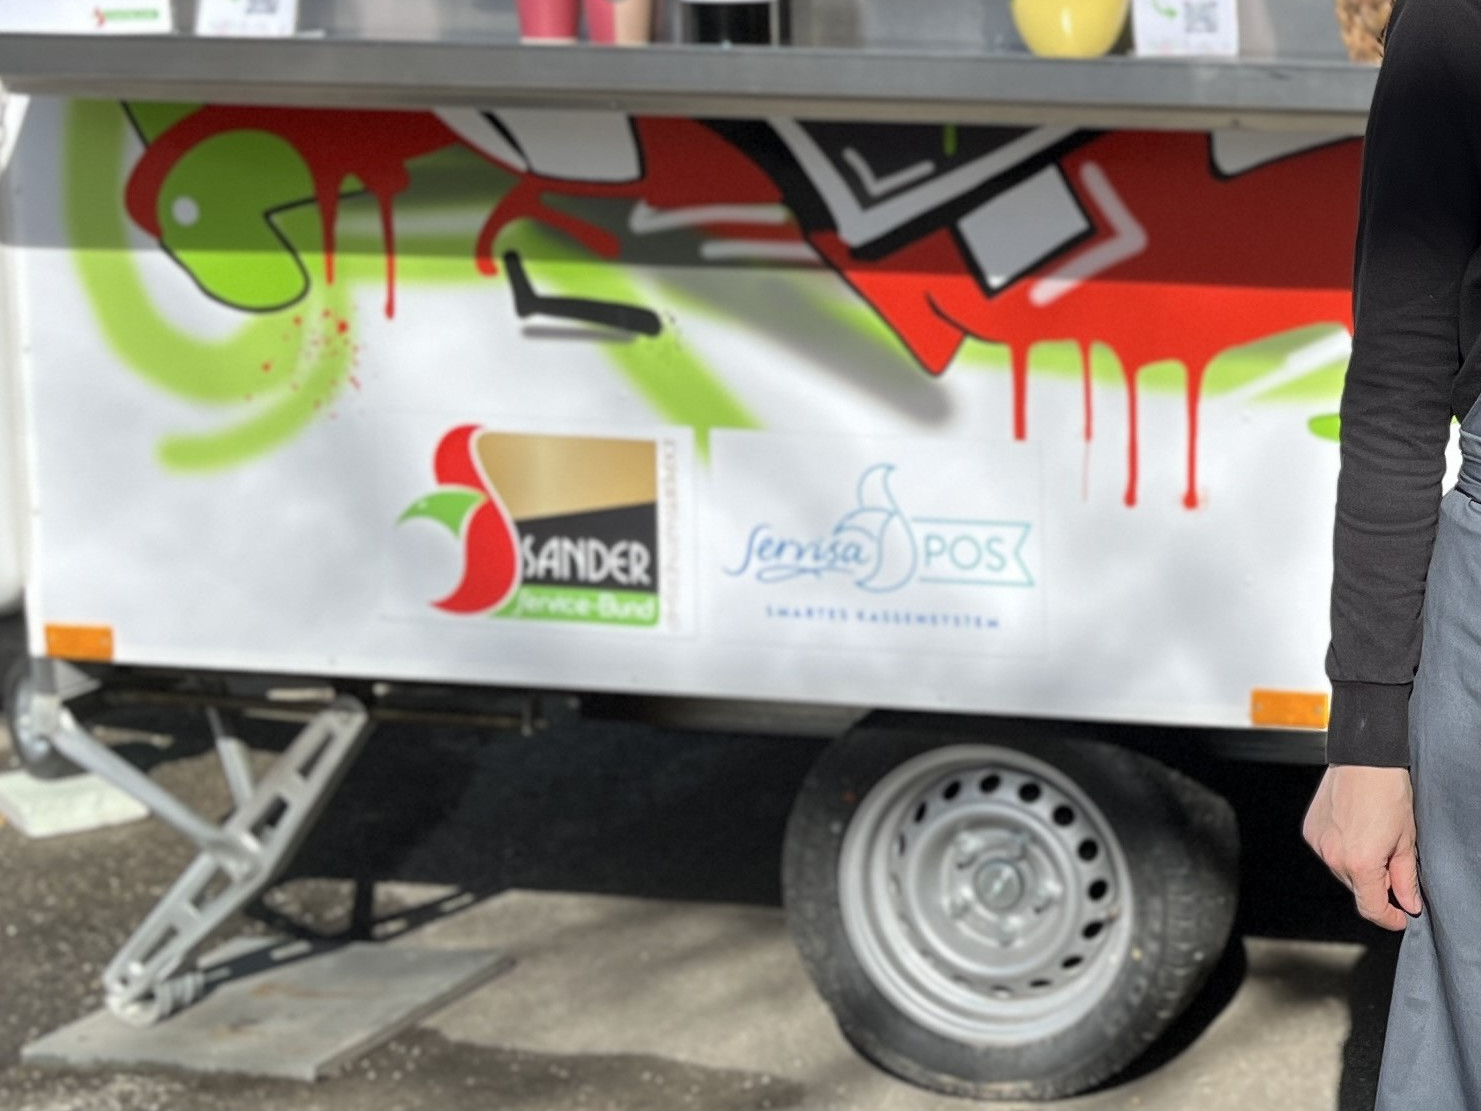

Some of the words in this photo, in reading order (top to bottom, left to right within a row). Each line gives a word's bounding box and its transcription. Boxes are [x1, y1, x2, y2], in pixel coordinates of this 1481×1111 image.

[522, 534, 653, 586] SANDER
[924, 533, 1007, 572] POS
[765, 604, 849, 622] SMARTES
[856, 608, 999, 629] KASSENSYSTEM
